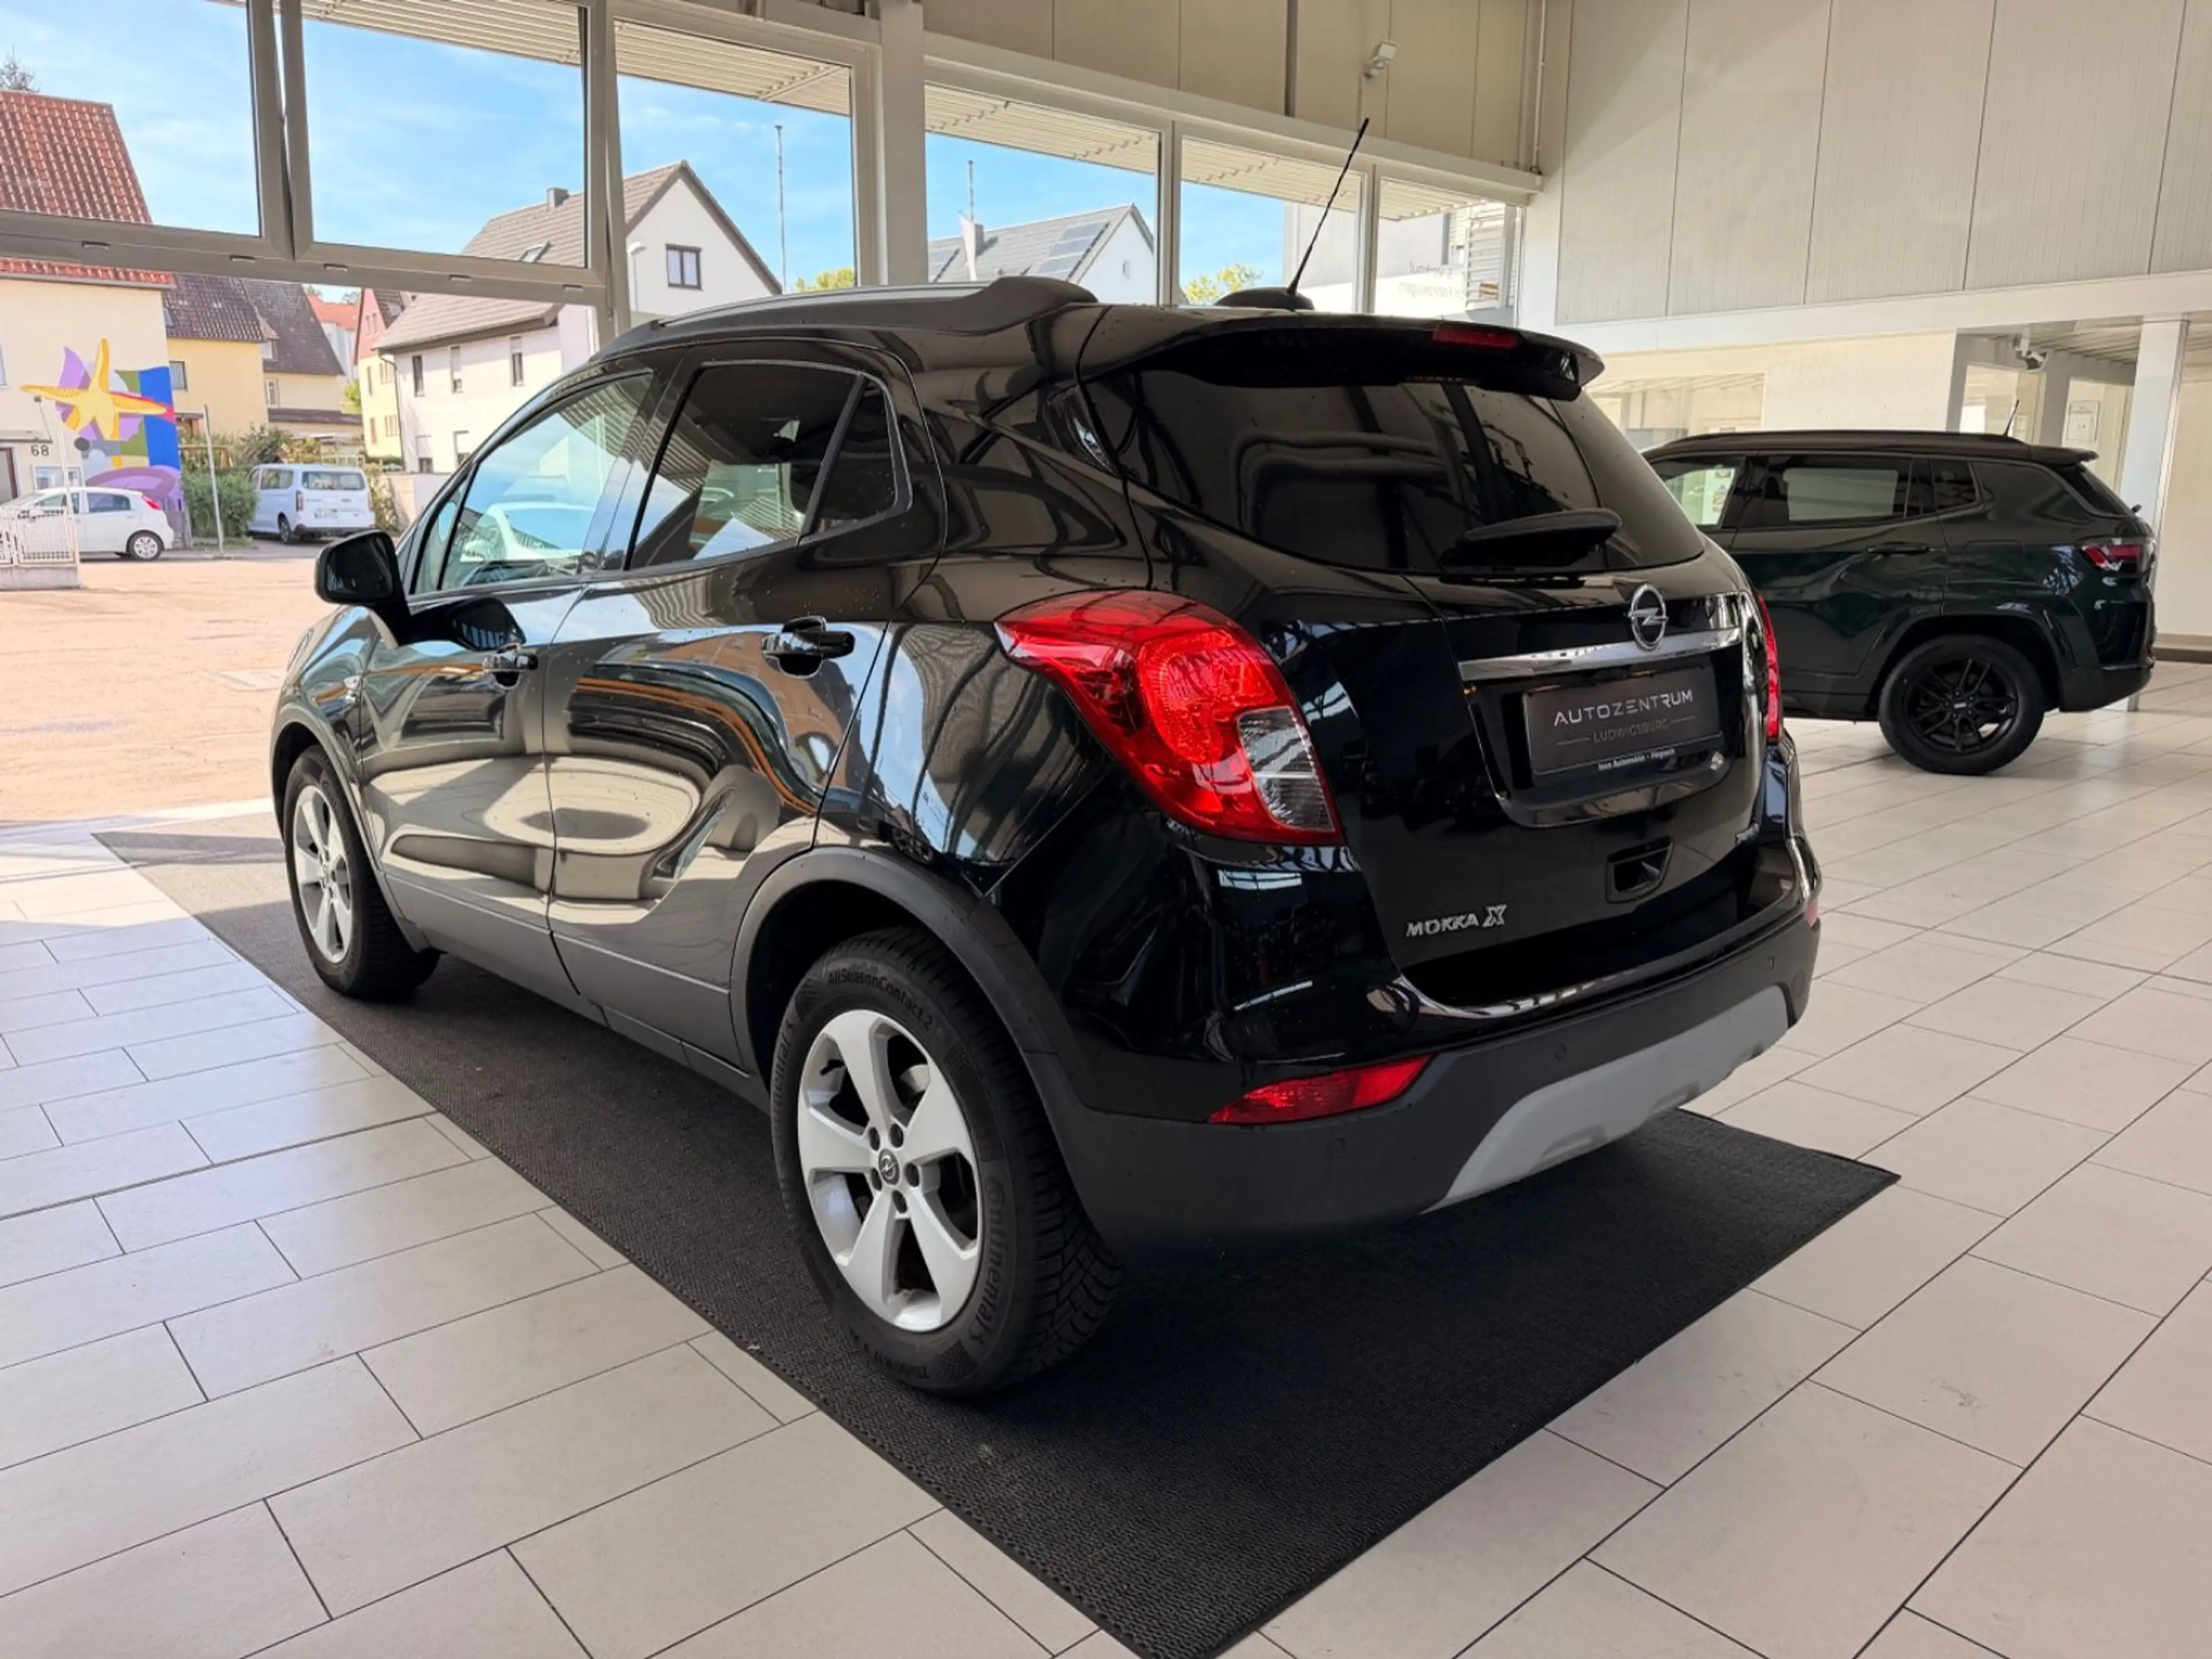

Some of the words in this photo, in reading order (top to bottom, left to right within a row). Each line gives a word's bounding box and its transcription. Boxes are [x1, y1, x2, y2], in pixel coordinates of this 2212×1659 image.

[31, 444, 50, 457] 68
[1554, 689, 1693, 727] AUTOZENTRUM
[1406, 913, 1479, 937] MOKKA
[1482, 903, 1508, 927] X
